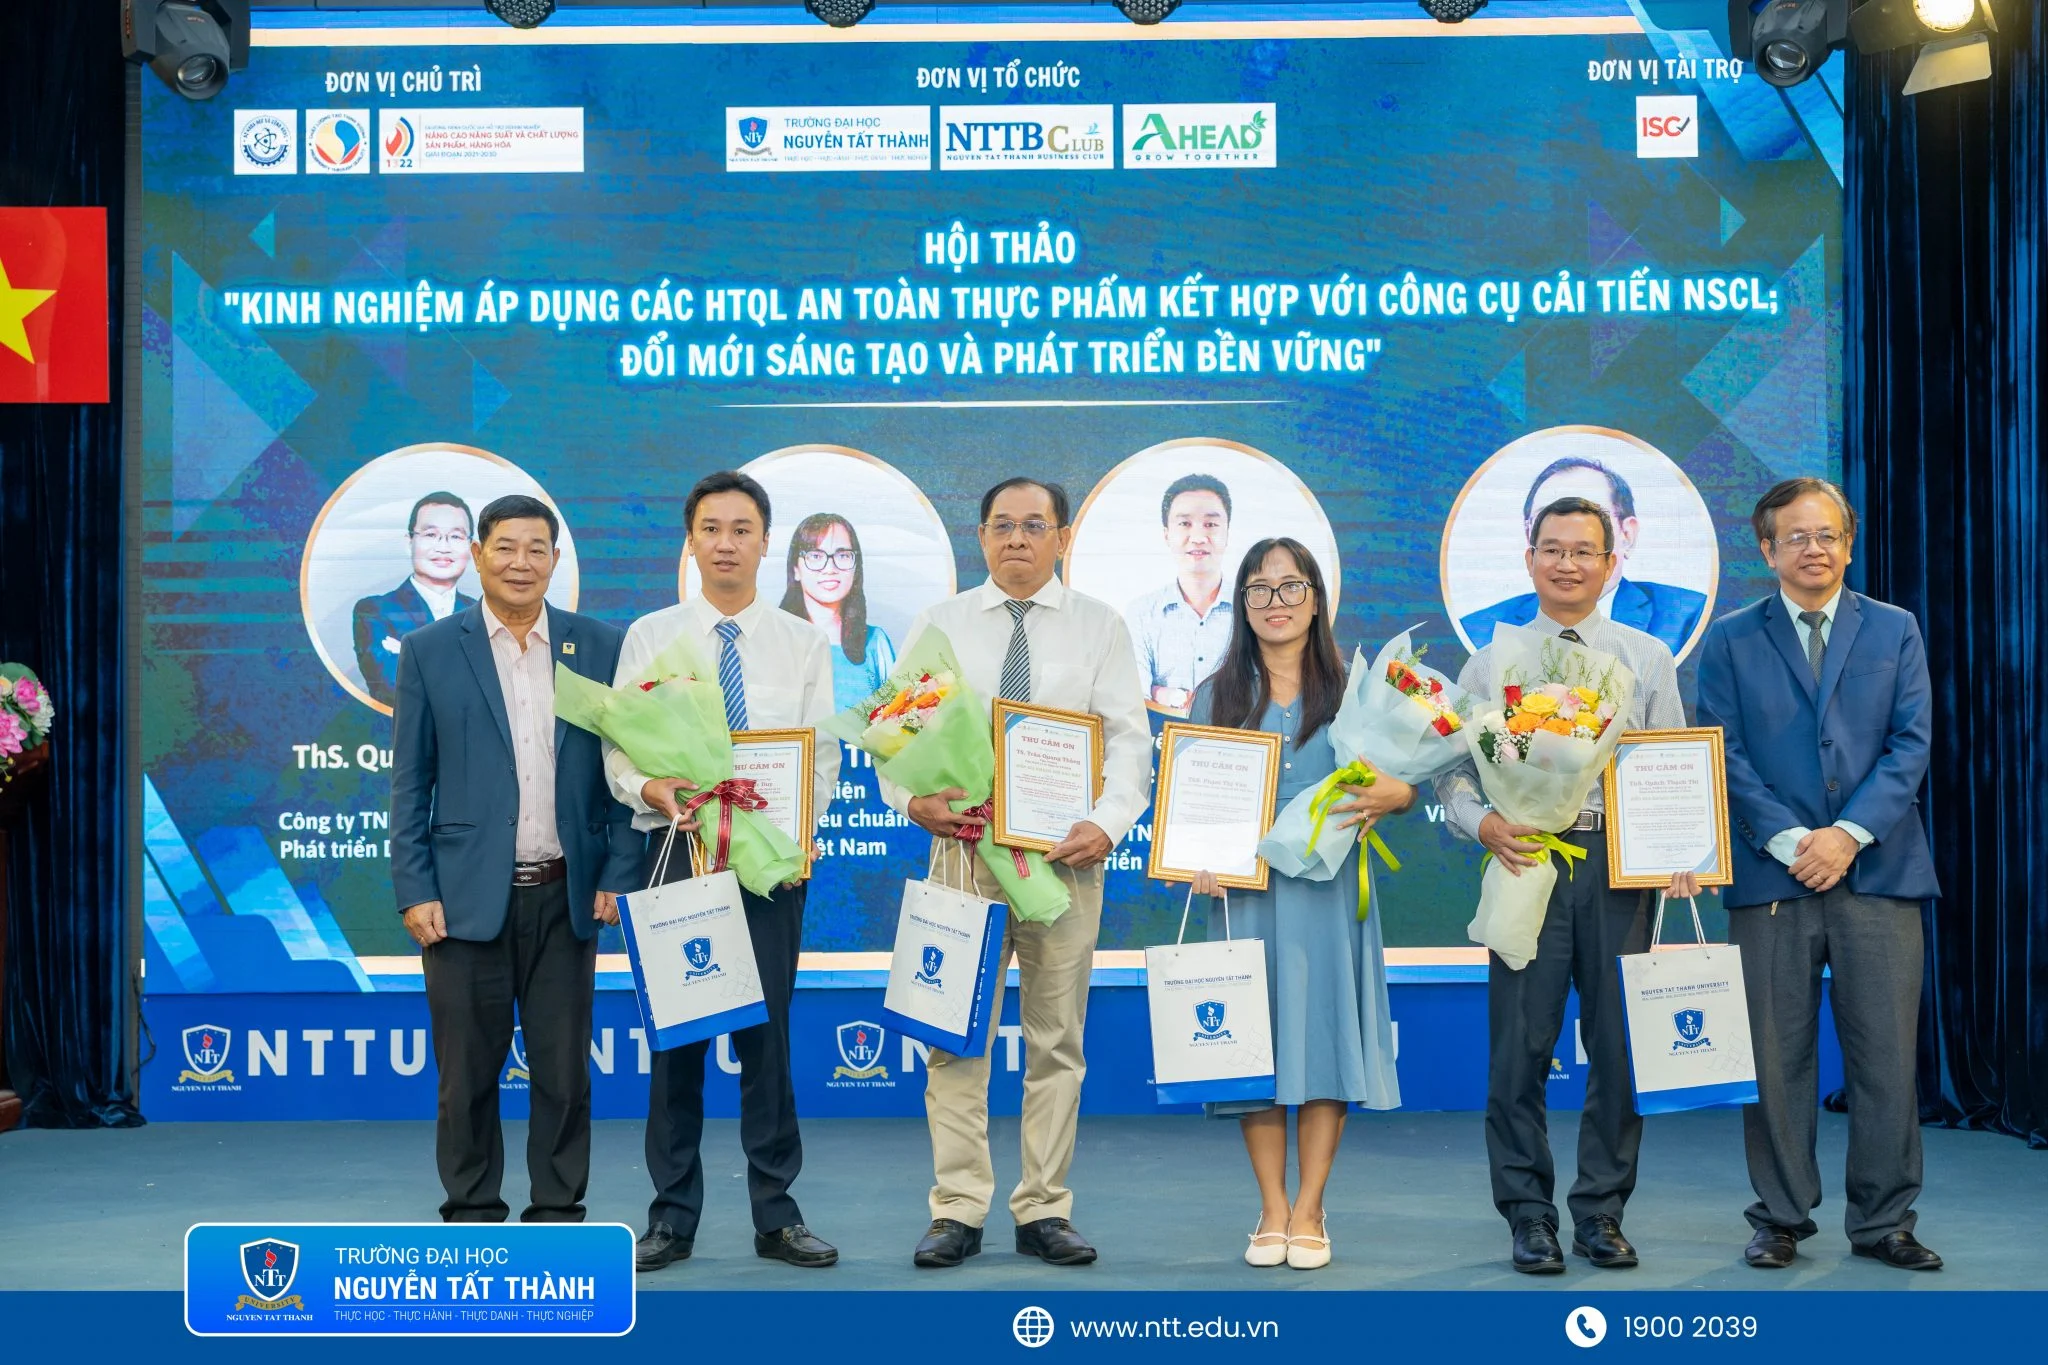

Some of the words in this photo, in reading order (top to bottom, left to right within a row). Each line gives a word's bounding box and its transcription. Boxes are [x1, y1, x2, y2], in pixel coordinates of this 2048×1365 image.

[916, 67, 961, 88] ĐƠN
[967, 67, 987, 93] VỊ
[993, 58, 1021, 88] TỔ
[1024, 61, 1080, 88] CHỨC
[1588, 58, 1632, 82] ĐƠN
[1638, 59, 1658, 85] VỊ
[1665, 52, 1697, 81] TÀI
[1703, 57, 1744, 84] TRỢ
[325, 70, 370, 93] ĐƠN
[376, 71, 396, 97] VỊ
[402, 64, 443, 93] CHỦ
[449, 65, 482, 92] TRÌ
[784, 116, 832, 128] TRƯỜNG
[834, 118, 853, 130] ĐẠI
[856, 117, 881, 130] HỌC
[1132, 112, 1263, 151] AHEAD
[783, 130, 839, 149] NGUYỄN
[847, 131, 872, 149] TẤT
[877, 131, 929, 149] THÀNH
[1135, 153, 1175, 161] GROW
[1185, 153, 1258, 161] TOGETHER
[924, 220, 979, 273] HỘI
[991, 220, 1076, 264] THẢO
[223, 290, 320, 324] "KINH
[334, 279, 463, 332] NGHIỆM
[475, 279, 519, 323] ÁP
[530, 289, 620, 330] DỤNG
[631, 278, 694, 322] CÁC
[706, 287, 787, 328] HTQL
[797, 288, 841, 320] AN
[854, 276, 940, 321] TOÀN
[951, 285, 1040, 328] THỰC
[1160, 271, 1220, 318] KẾT
[1231, 282, 1299, 326] HỢP
[1309, 272, 1367, 317] VỚI
[1379, 271, 1468, 316] CÔNG
[1479, 281, 1520, 323] CỤ
[1532, 269, 1586, 314] CẢI
[1597, 265, 1671, 313] TIẾN
[1683, 277, 1778, 315] NSCL;
[620, 330, 675, 378] ĐỔI
[688, 333, 755, 377] MỚI
[766, 332, 856, 376] SÁNG
[865, 341, 928, 383] TẠO
[938, 331, 982, 375] VÀ
[995, 330, 1079, 374] PHÁT
[1088, 326, 1185, 374] TRIỂN
[1197, 328, 1261, 373] BỀN
[1272, 330, 1382, 372] VỮNG"
[292, 742, 350, 769] ThS.
[356, 744, 394, 772] Qu
[831, 781, 866, 804] iện
[279, 811, 332, 834] Công
[336, 812, 355, 834] ty
[359, 811, 391, 830] TN
[280, 839, 327, 859] Phát
[331, 836, 378, 858] triển
[816, 837, 834, 860] ệt
[839, 838, 887, 856] Nam
[1103, 849, 1143, 871] riển
[1641, 988, 1663, 996] NGUYEN
[1696, 981, 1729, 990] UNIVERSITY
[194, 1048, 220, 1064] NTT
[247, 1028, 427, 1076] NTTU
[849, 1045, 874, 1061] NTT
